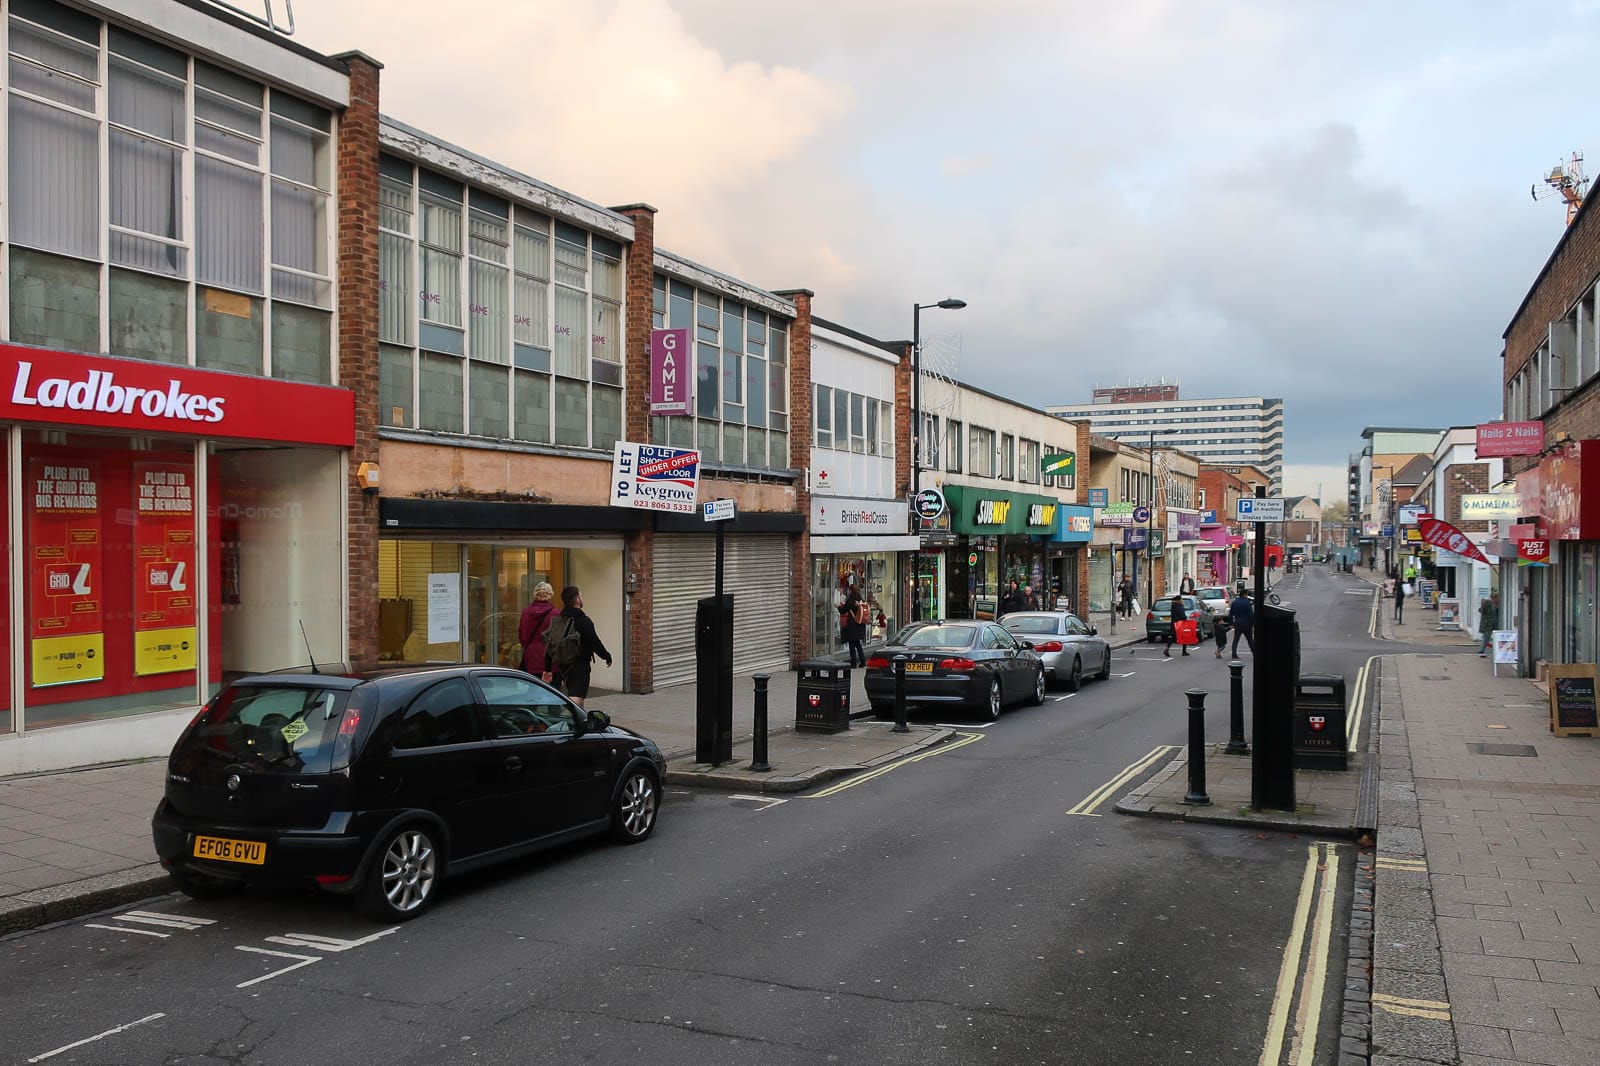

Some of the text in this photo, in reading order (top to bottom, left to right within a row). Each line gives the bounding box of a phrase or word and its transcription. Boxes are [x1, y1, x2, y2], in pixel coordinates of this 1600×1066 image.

[420, 291, 440, 304] GAME
[469, 303, 488, 316] GAME
[514, 314, 531, 326] GAME
[554, 325, 570, 336] GAME
[592, 334, 606, 345] GAME
[662, 333, 676, 402] GAME
[12, 361, 226, 423] Ladbrokes
[1480, 427, 1539, 439] Nails 2 Nails
[641, 447, 676, 458] TO LET
[640, 454, 697, 475] UNDER OFFER
[1045, 456, 1073, 474] SUBWAY
[44, 466, 89, 481] PLUG INTO
[145, 472, 185, 486] PLUG INTO
[618, 450, 632, 498] TO LET
[37, 480, 96, 495] THE GRID FOR
[139, 485, 191, 498] THE GRID FOR
[636, 483, 694, 500] Keygrove
[36, 494, 97, 508] BIG REWARDS
[139, 498, 192, 511] BIG REWARDS
[634, 500, 693, 512] 023 8063 5333
[841, 510, 888, 525] BritishRedCross
[977, 500, 1012, 525] SUBWAY
[1030, 504, 1056, 526] SUBWAY
[1522, 541, 1544, 550] JUST
[1526, 548, 1544, 556] EAT
[50, 573, 70, 589] GRID
[150, 571, 168, 585] GRID
[199, 838, 260, 860] EF06 GVU
